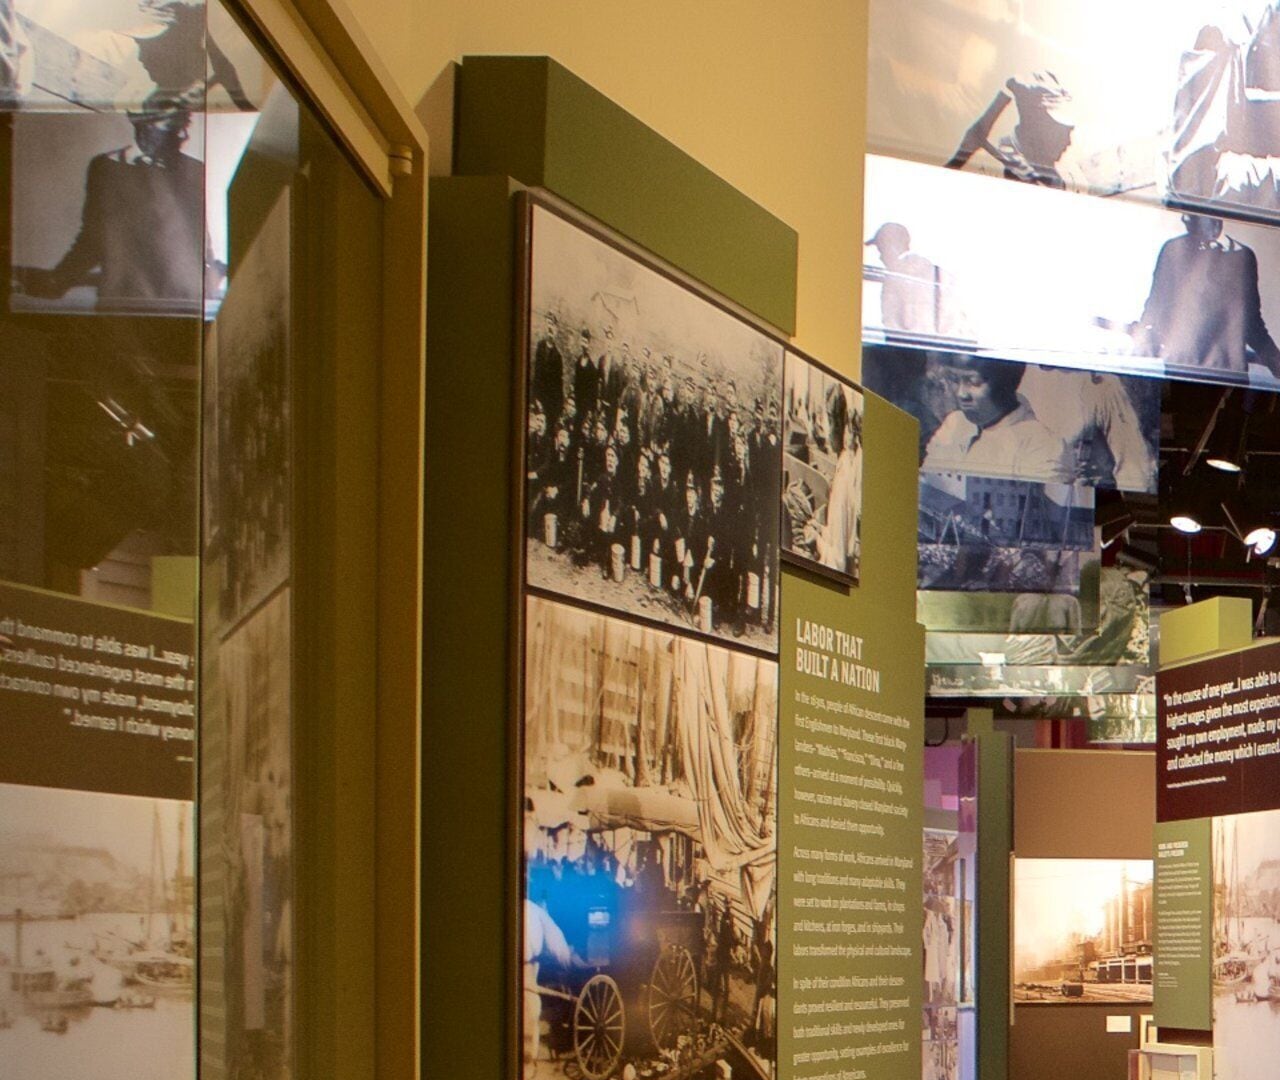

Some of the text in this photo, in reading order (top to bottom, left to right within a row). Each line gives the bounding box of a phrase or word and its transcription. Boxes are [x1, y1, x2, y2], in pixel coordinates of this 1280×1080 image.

[796, 618, 863, 659] LABOR THAT
[796, 648, 880, 693] BUILT A NATION
[1172, 691, 1182, 706] the
[1182, 689, 1202, 704] course
[1202, 683, 1208, 700] of
[1208, 684, 1220, 698] one
[1241, 677, 1254, 691] was
[1254, 671, 1269, 688] able
[1269, 671, 1277, 685] to
[1166, 712, 1187, 730] highest
[1187, 710, 1205, 726] wages
[1204, 705, 1222, 724] given
[1221, 702, 1232, 718] the
[1232, 699, 1249, 715] most
[1166, 733, 1186, 751] sought
[1186, 734, 1195, 748] my
[1195, 731, 1207, 744] own
[1207, 722, 1247, 744] employment,
[1247, 718, 1265, 735] made
[1266, 719, 1276, 734] my
[1166, 755, 1178, 771] and
[1178, 750, 1203, 769] collected
[1203, 750, 1214, 765] the
[1214, 749, 1234, 764] money
[1233, 742, 1253, 760] which
